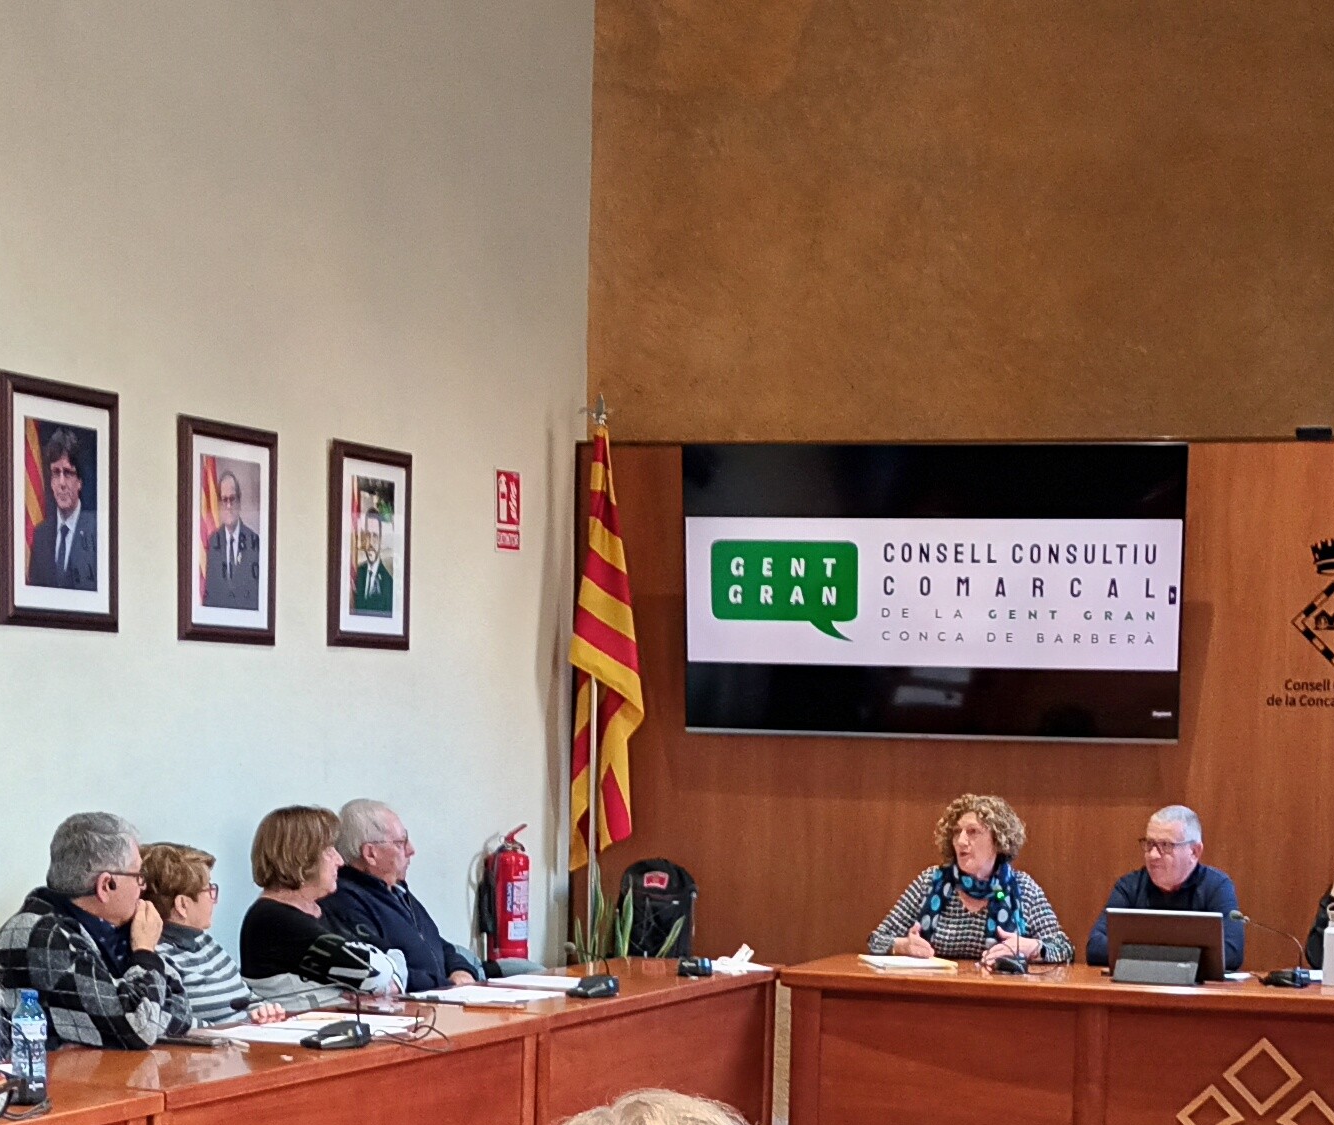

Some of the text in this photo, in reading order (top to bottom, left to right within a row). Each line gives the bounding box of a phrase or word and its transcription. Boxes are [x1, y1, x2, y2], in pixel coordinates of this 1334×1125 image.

[883, 542, 1157, 565] CONSELL CONSULTIU
[730, 556, 837, 578] GENT
[728, 584, 837, 606] GRAN
[883, 575, 1156, 599] COMARCAL
[881, 607, 1156, 622] DE LA GENT GRAN
[881, 630, 1155, 645] CONCA DE BARBERÀ
[1284, 678, 1331, 692] Consell
[1267, 693, 1283, 707] de
[1285, 693, 1297, 707] la
